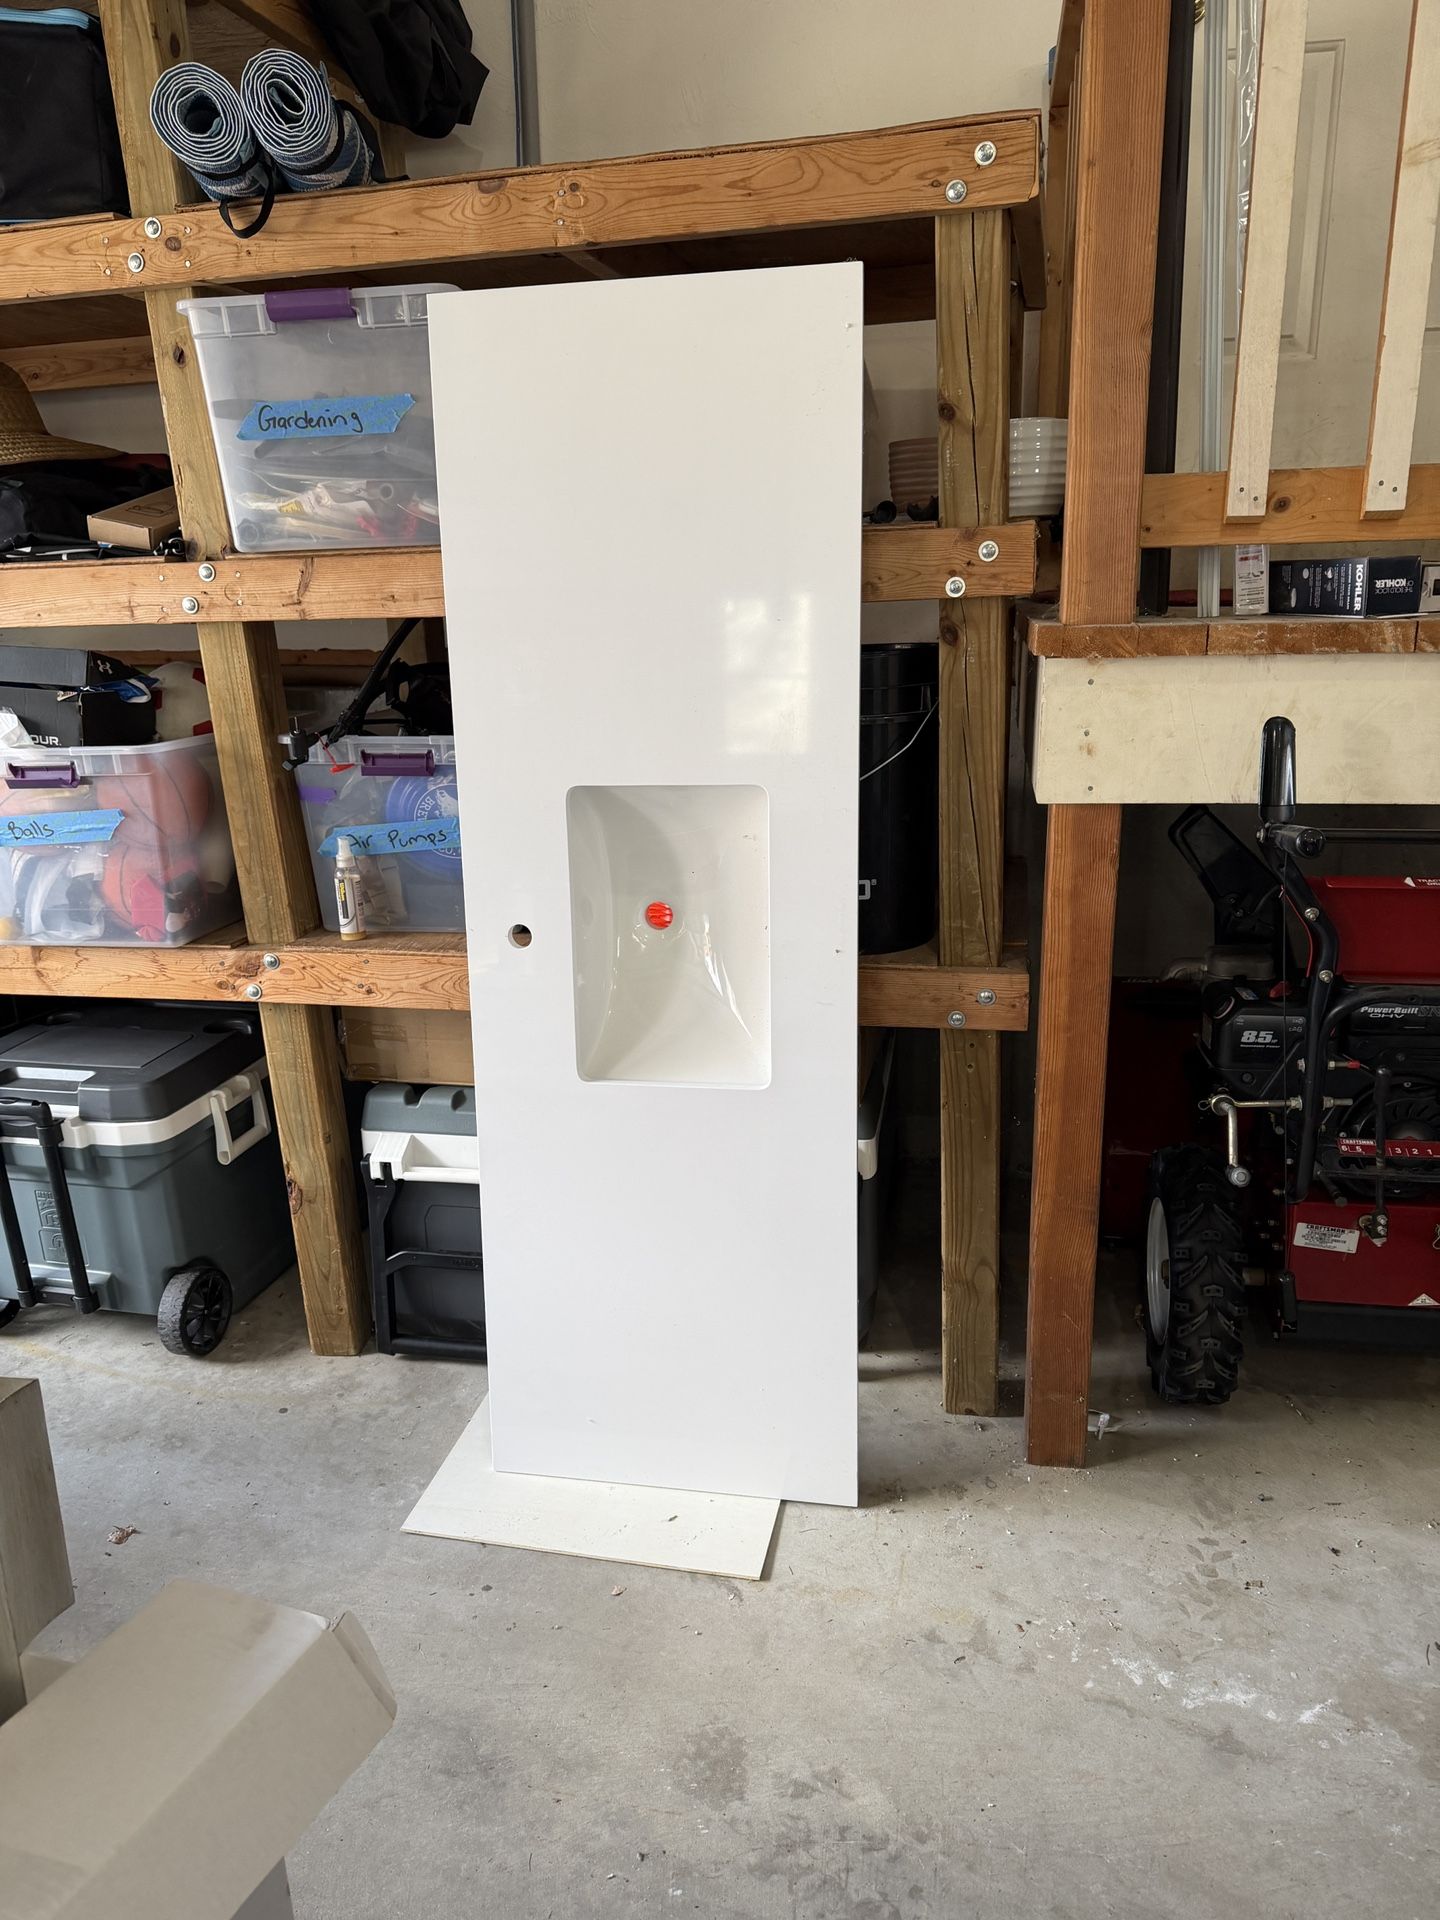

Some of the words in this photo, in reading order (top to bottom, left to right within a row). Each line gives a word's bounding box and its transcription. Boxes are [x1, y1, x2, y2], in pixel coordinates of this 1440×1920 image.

[258, 405, 363, 433] Gardening
[1353, 564, 1364, 612] KOHLER
[1375, 578, 1407, 588] KOHLER
[417, 796, 435, 822] BRE
[8, 821, 54, 841] Balls
[346, 833, 373, 849] Air
[387, 829, 447, 849] Pumps
[1360, 1006, 1419, 1014] PowerBuilt
[1240, 1030, 1274, 1043] 8.5
[1306, 1224, 1346, 1234] CRAFTSMAN
